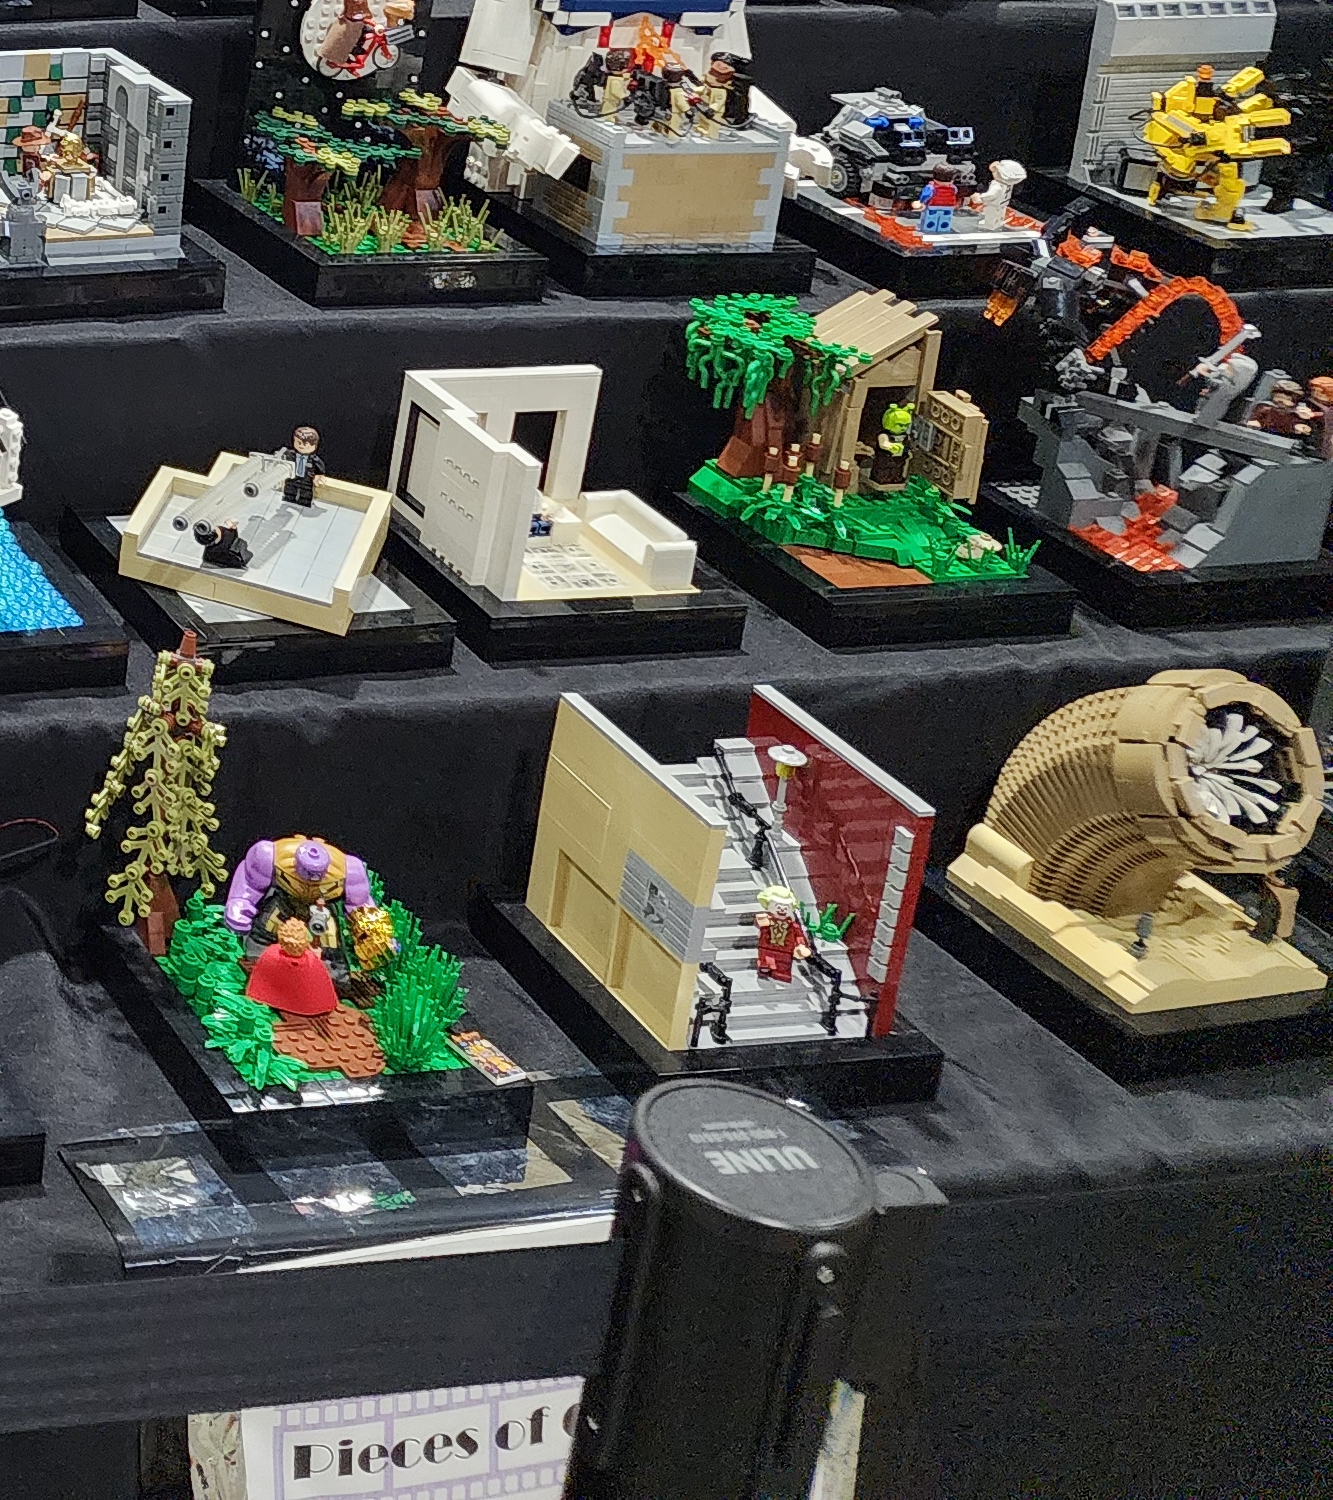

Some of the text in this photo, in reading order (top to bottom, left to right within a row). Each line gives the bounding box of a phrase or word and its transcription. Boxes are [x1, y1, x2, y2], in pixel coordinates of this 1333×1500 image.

[704, 1145, 820, 1175] ULINE
[293, 1426, 479, 1481] Pieces
[494, 1405, 551, 1451] of
